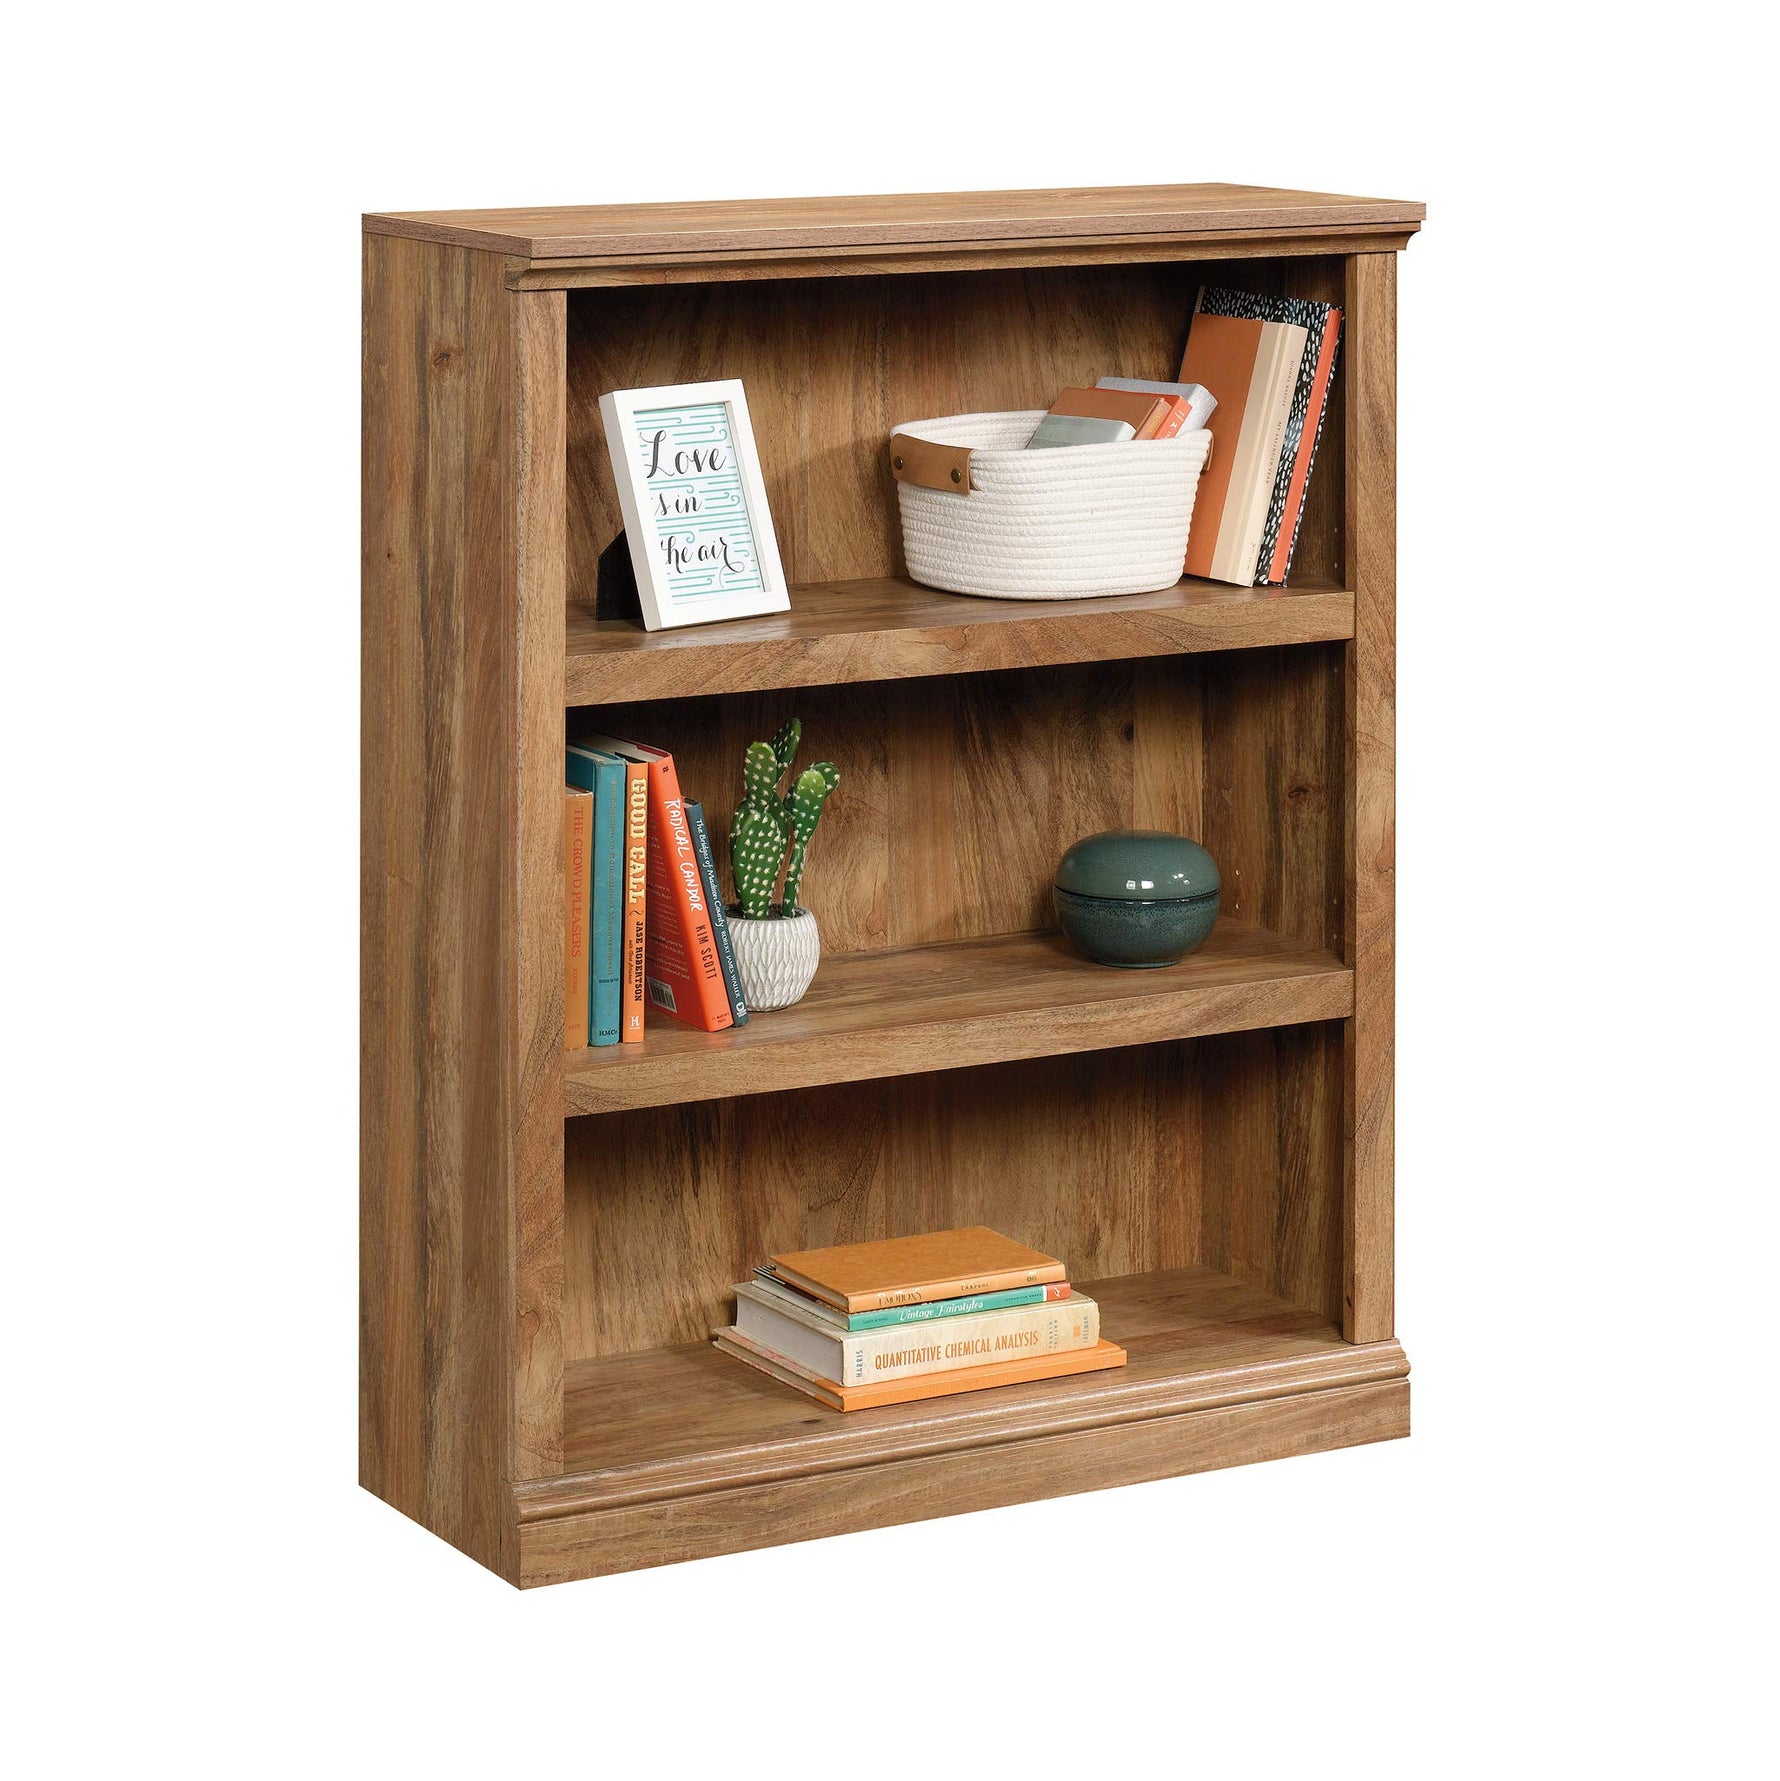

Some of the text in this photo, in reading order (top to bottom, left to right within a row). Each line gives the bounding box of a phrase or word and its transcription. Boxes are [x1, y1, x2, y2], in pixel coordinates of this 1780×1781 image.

[639, 430, 727, 478] Love
[675, 494, 703, 514] in
[698, 537, 744, 588] air
[628, 778, 648, 904] GOOD CALL
[663, 798, 704, 911] RADICAL CANDOR
[571, 807, 584, 957] THE CROWD PLEASERS
[696, 818, 726, 928] The Bridges of Madison County
[634, 920, 644, 1002] JASE ROBERTSON
[696, 924, 717, 979] KIM SCOTT
[720, 930, 741, 999] ROBERT JAMES WALLER
[898, 1308, 934, 1321] Vintage
[937, 1299, 984, 1317] Hairstyles
[855, 1350, 864, 1377] HARRIS
[874, 1330, 1039, 1370] QUANTITATIVE CHEMICAL ANALYSIS
